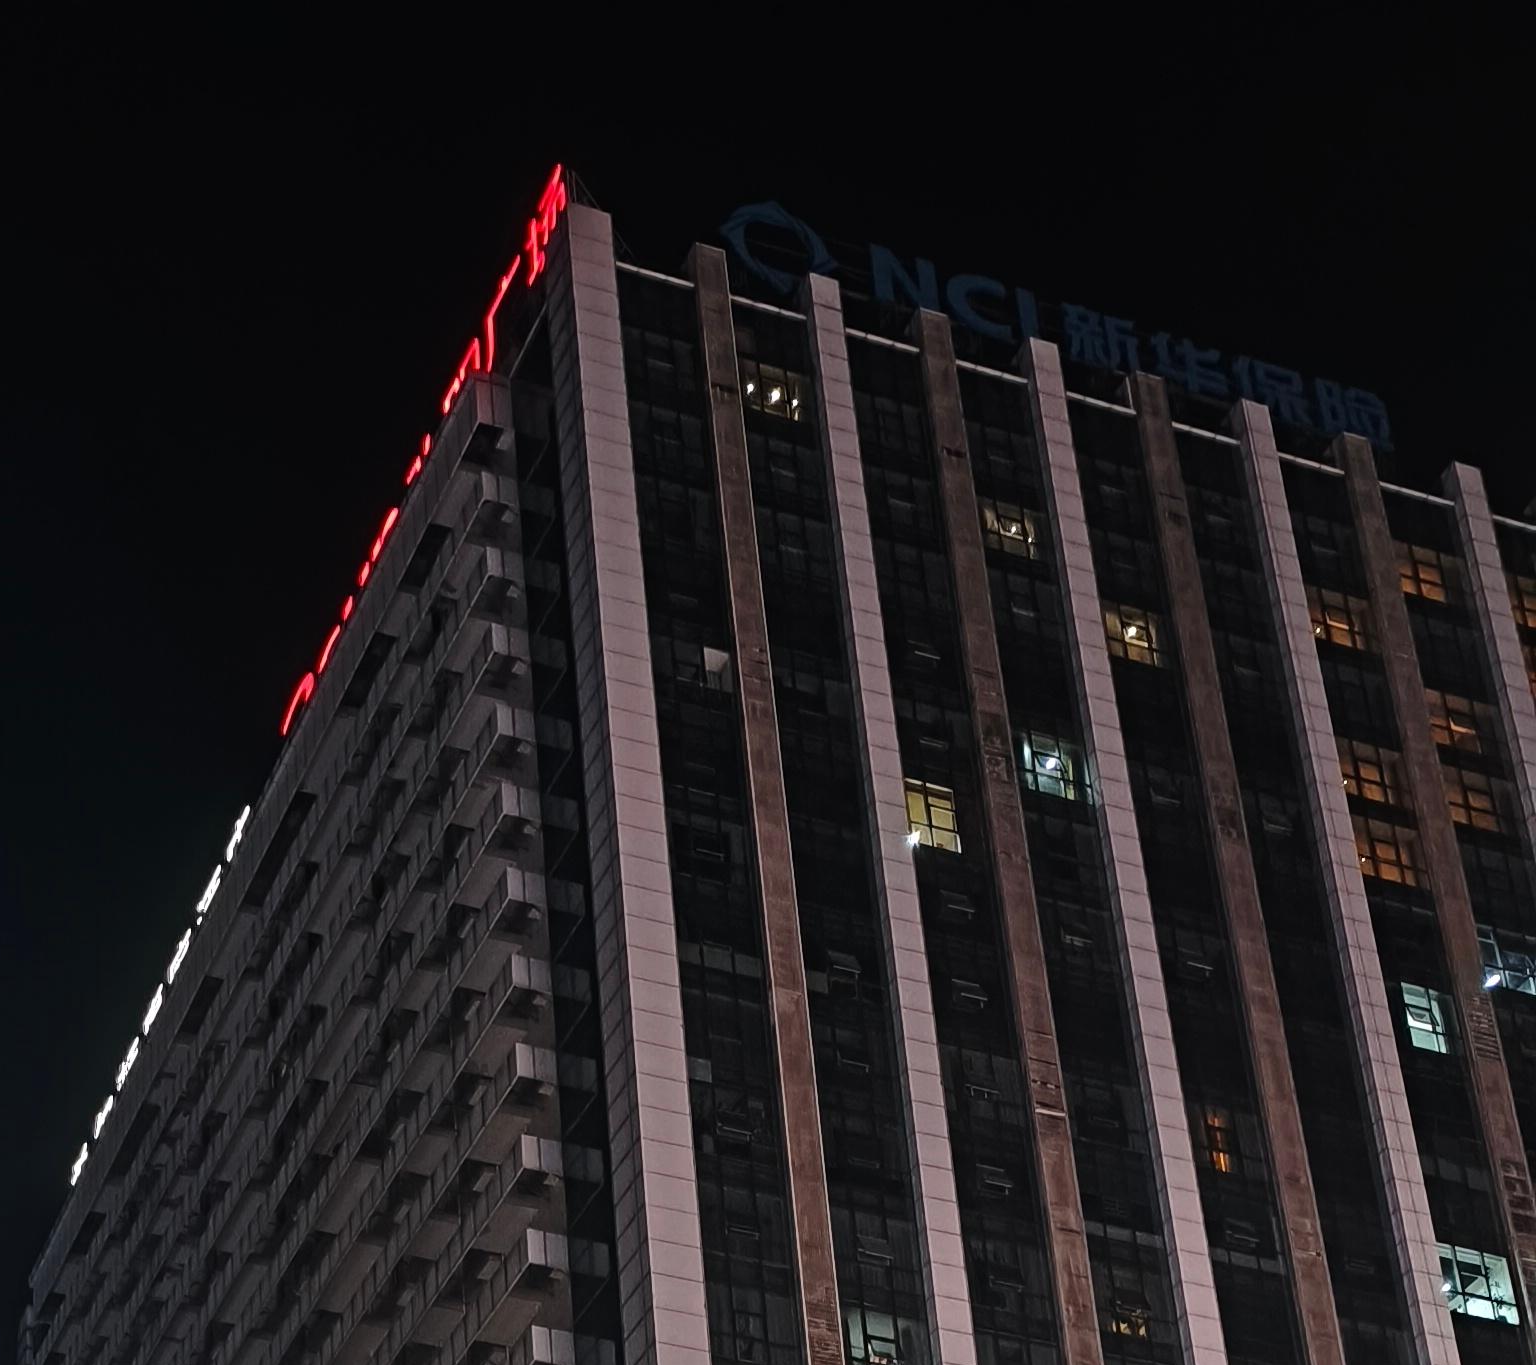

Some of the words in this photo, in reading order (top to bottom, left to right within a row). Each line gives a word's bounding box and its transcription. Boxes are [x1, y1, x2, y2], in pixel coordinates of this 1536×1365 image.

[869, 243, 1041, 340] NCI
[1061, 302, 1395, 452] 新华保险
